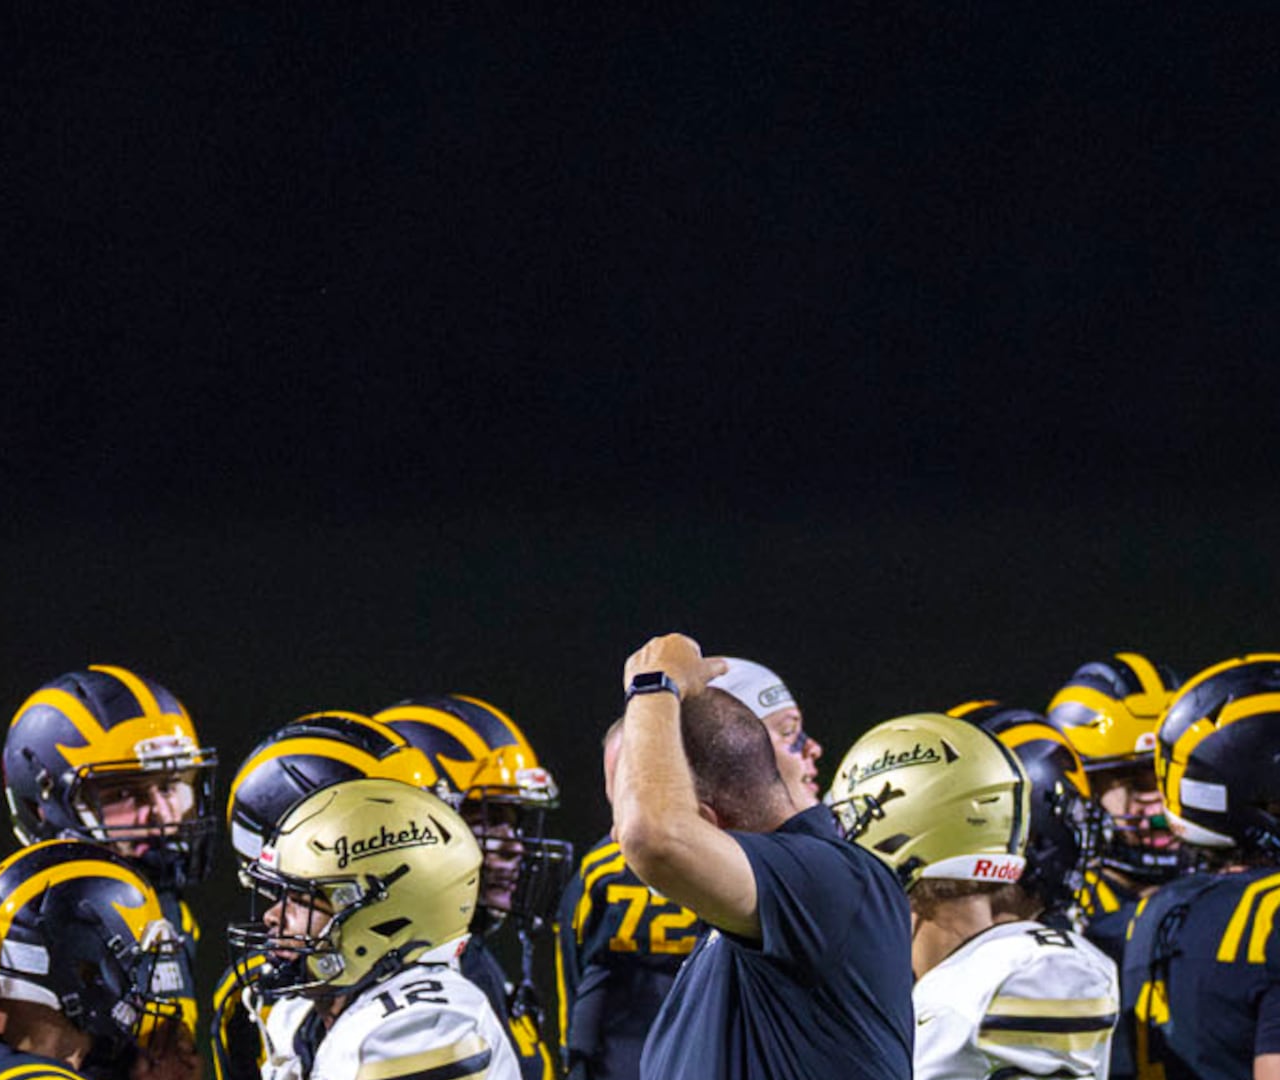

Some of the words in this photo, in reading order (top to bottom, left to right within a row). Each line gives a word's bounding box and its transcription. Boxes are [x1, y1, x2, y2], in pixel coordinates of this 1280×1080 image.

[331, 820, 438, 868] Jackets
[607, 884, 699, 954] 72
[372, 979, 450, 1019] 12
